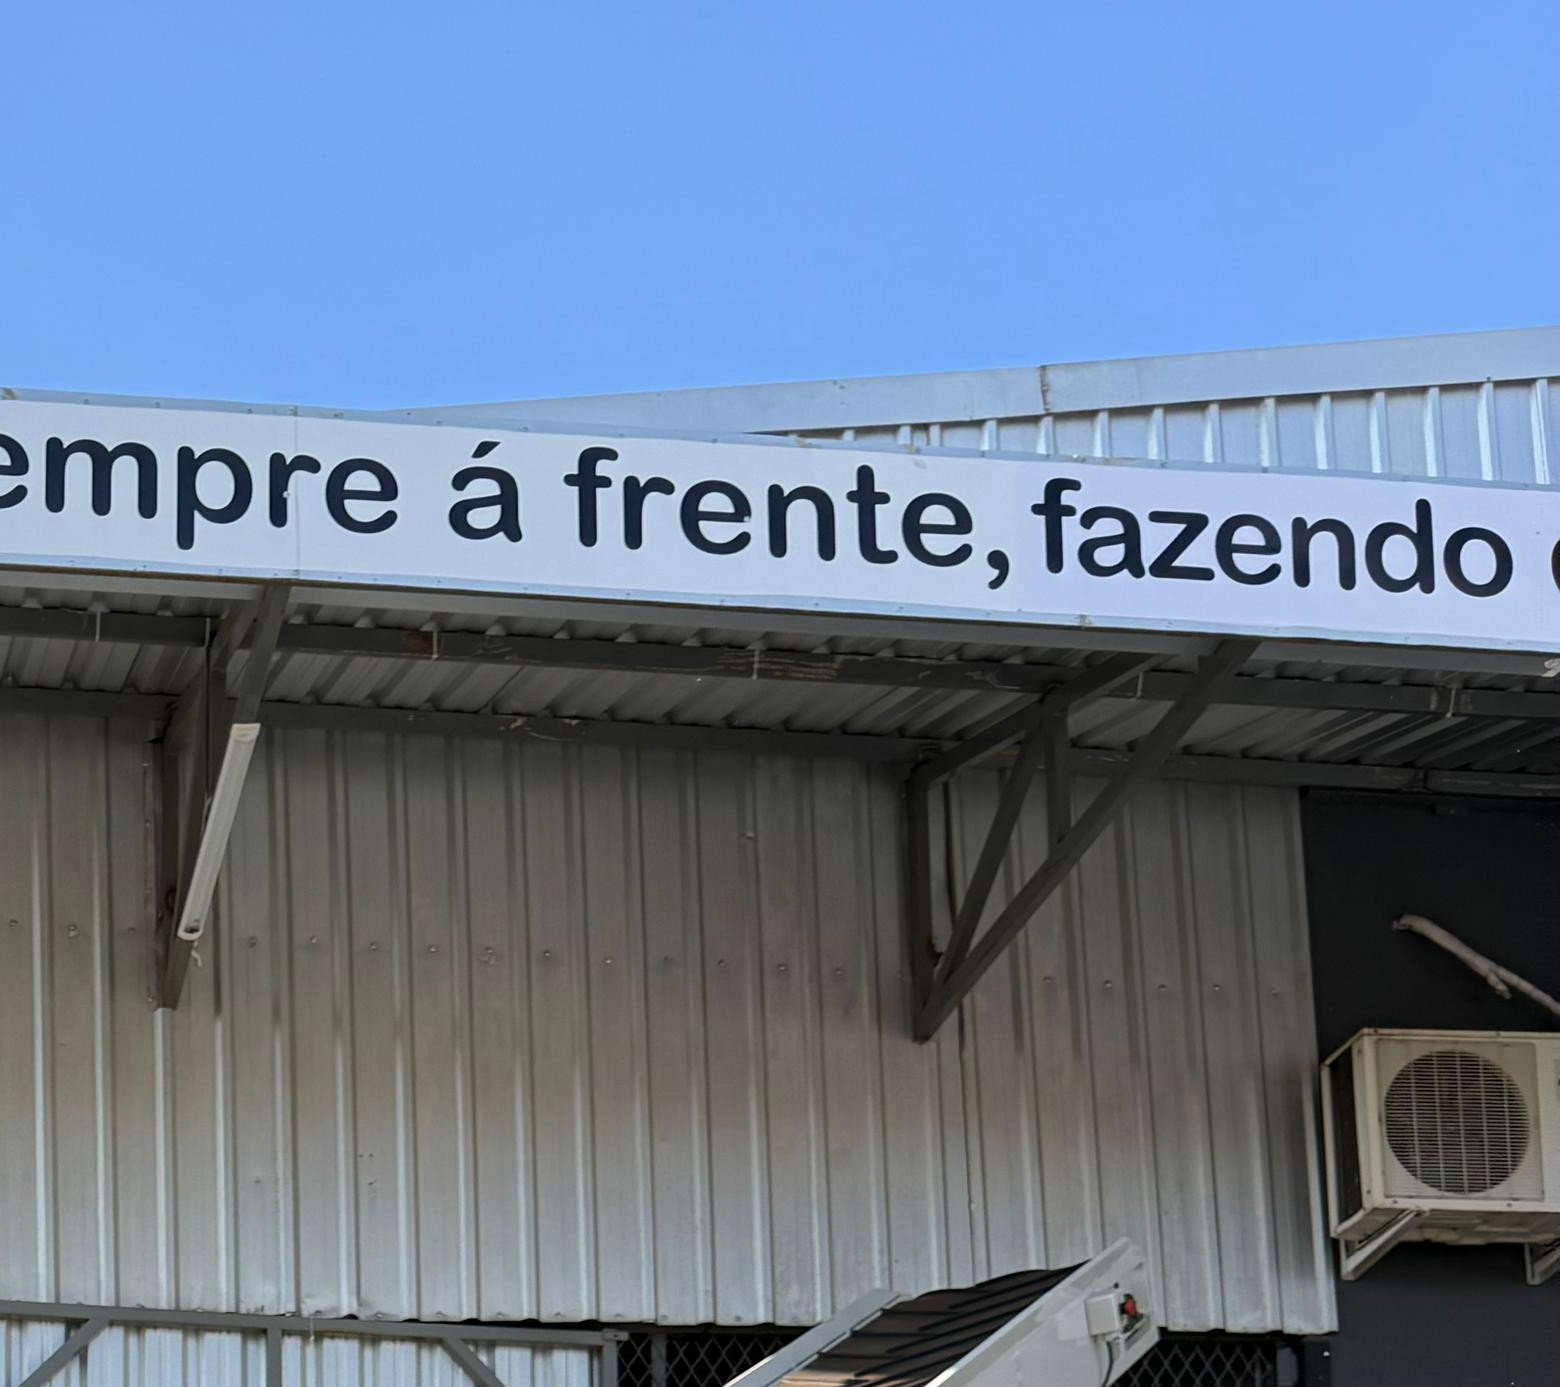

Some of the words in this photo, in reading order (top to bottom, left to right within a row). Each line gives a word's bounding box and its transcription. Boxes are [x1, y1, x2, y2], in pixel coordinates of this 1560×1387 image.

[448, 441, 523, 543] á
[563, 446, 1011, 590] frente,
[1030, 477, 1515, 598] fazendo
